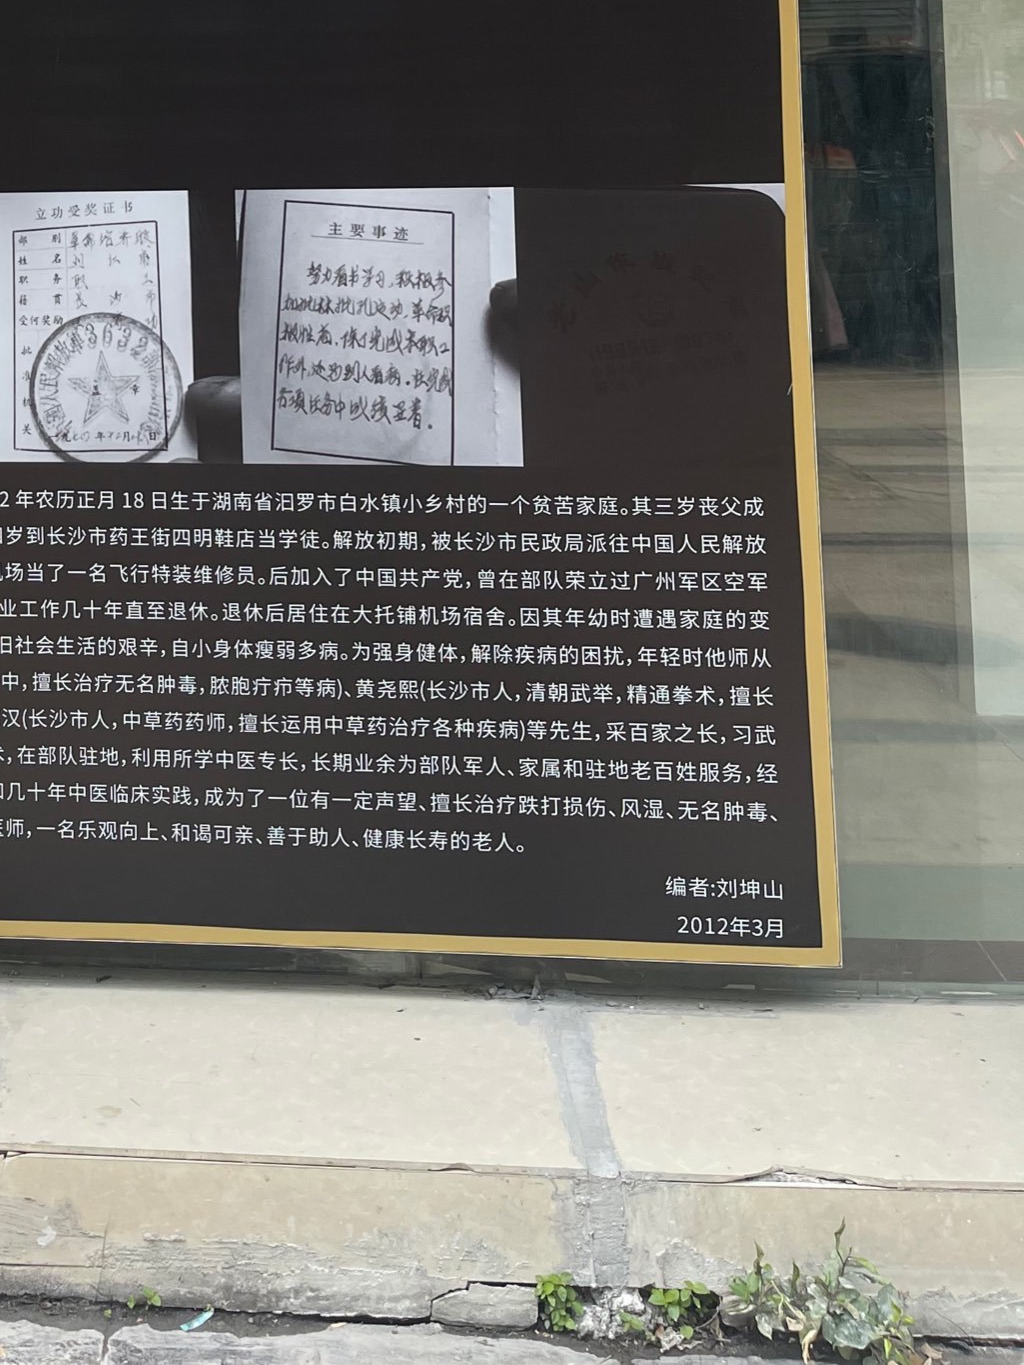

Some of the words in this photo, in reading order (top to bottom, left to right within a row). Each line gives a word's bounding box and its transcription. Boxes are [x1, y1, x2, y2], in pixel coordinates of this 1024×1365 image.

[327, 221, 410, 242] 主要事迹
[665, 876, 784, 901] 编者:刘坤山
[677, 916, 784, 939] 2012年3月
